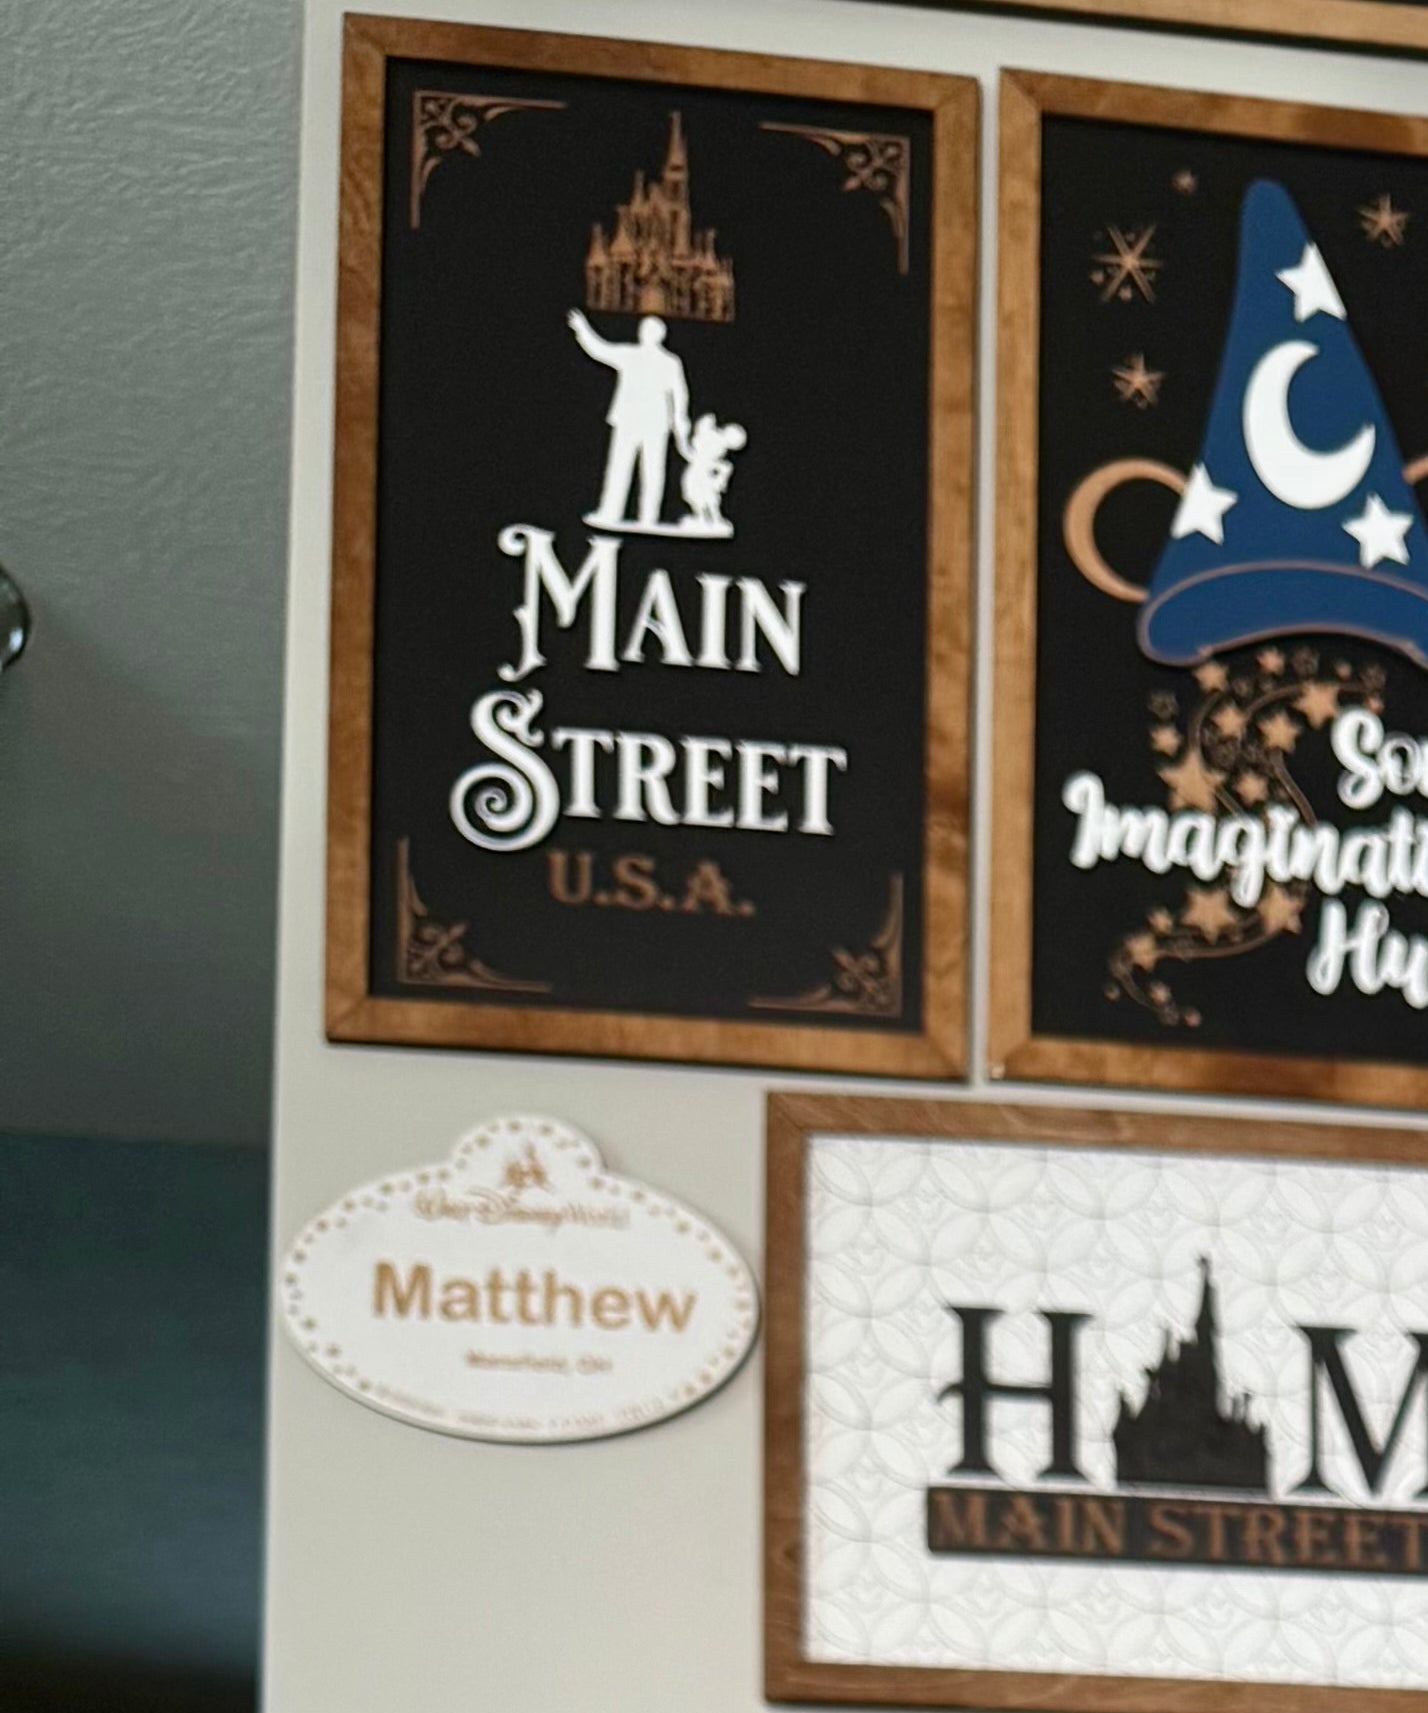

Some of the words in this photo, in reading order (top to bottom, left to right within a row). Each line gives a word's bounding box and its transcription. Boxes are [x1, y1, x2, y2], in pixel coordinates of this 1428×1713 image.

[497, 523, 807, 682] MAIN
[449, 688, 848, 852] STREET
[546, 848, 756, 917] U.S.A.
[371, 1261, 698, 1334] Matthew
[930, 1490, 1129, 1556] MAIN
